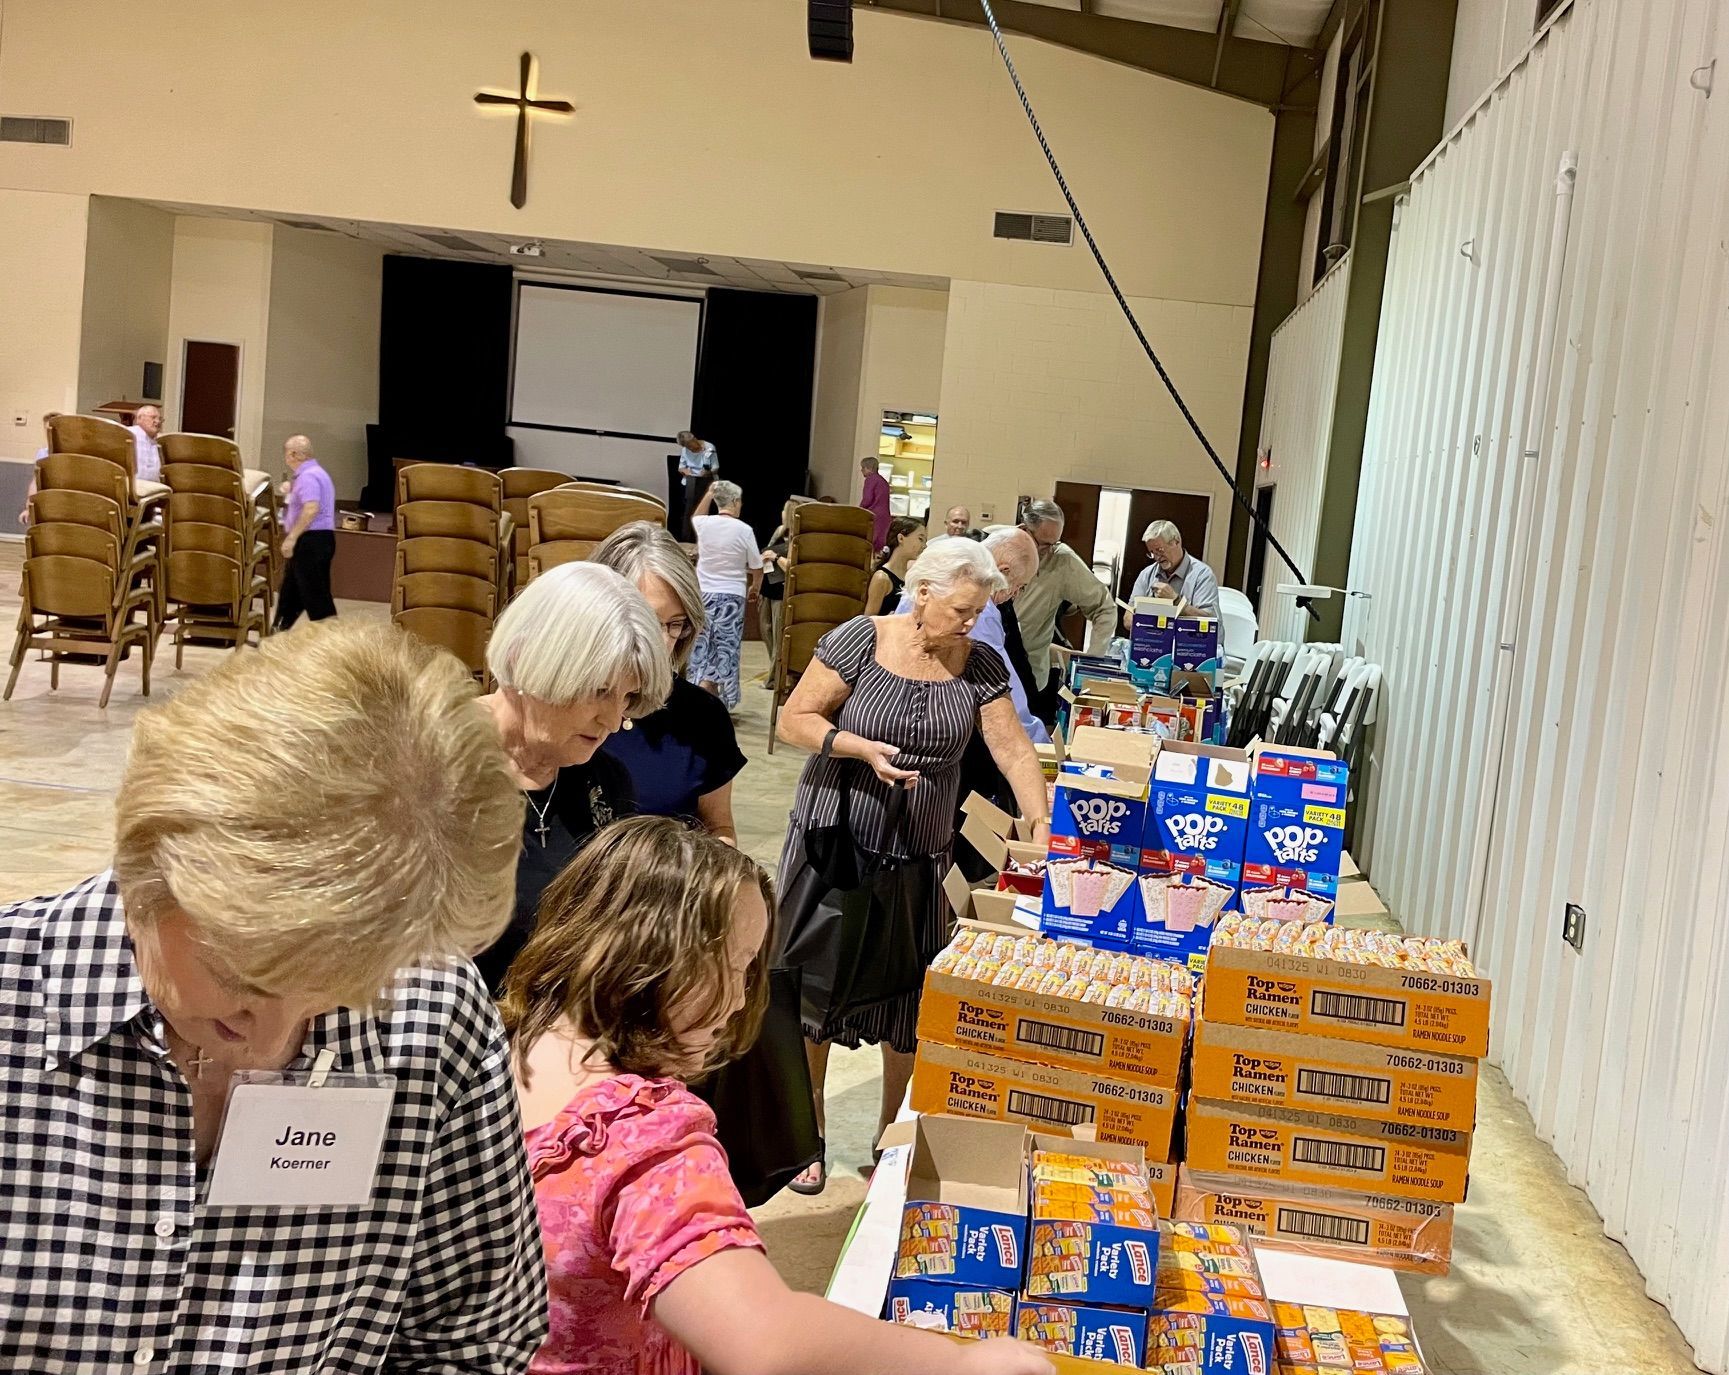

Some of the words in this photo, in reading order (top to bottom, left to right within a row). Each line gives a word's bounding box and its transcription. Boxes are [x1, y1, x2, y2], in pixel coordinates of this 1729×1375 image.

[1266, 957, 1309, 972] 041325
[1338, 966, 1366, 980] 0830
[1247, 976, 1275, 992] Top
[1401, 976, 1479, 996] 70662-01303
[978, 990, 1016, 1003] 041325
[1043, 1002, 1070, 1014] 0830
[1247, 988, 1299, 1005] Ramen
[959, 1001, 984, 1017] Top
[1246, 1003, 1288, 1017] CHICKEN
[958, 1012, 1006, 1031] Ramen
[1101, 1011, 1172, 1033] 70662-01303
[956, 1026, 995, 1042] CHICKEN
[1412, 1029, 1430, 1040] RAMEN
[1432, 1032, 1452, 1042] NOODLE
[1453, 1035, 1466, 1044] SOUP
[1109, 1060, 1126, 1069] RAMEN
[1126, 1062, 1145, 1073] NOODLE
[1146, 1066, 1158, 1076] SOUP
[1233, 1054, 1261, 1070] Top
[1386, 1054, 1463, 1074] 70662-01303
[950, 1071, 975, 1088] Top
[967, 1060, 1006, 1074] 041325
[1032, 1073, 1058, 1085] 0830
[1233, 1066, 1286, 1083] Ramen
[950, 1082, 998, 1102] Ramen
[1092, 1081, 1163, 1104] 70662-01303
[1232, 1081, 1274, 1096] CHICKEN
[947, 1097, 986, 1113] CHICKEN
[1398, 1106, 1415, 1117] RAMEN
[1416, 1109, 1436, 1119] NOODLE
[1437, 1112, 1450, 1120] SOUP
[1258, 1107, 1300, 1121] 041325
[1329, 1117, 1356, 1129] 0830
[276, 1126, 336, 1146] Jane
[1230, 1124, 1257, 1139] Top
[1381, 1122, 1456, 1141] 70662-01303
[1229, 1135, 1281, 1151] Ramen
[270, 1157, 331, 1169] Koerner
[1228, 1151, 1270, 1164] CHICKEN
[1392, 1174, 1410, 1184] RAMEN
[1410, 1177, 1430, 1187] NOODLE
[1431, 1179, 1444, 1188] SOUP
[1215, 1194, 1242, 1209] Top
[1365, 1196, 1440, 1217] 70662-01303
[1214, 1204, 1265, 1222] Ramen
[967, 1230, 978, 1254] Pack
[976, 1226, 990, 1262] Variety
[998, 1227, 1013, 1265] Lance
[1100, 1247, 1111, 1272] Pack
[1109, 1243, 1122, 1279] Variety
[1131, 1244, 1146, 1282] Lance
[895, 1300, 905, 1322] nce
[1093, 1328, 1107, 1360] Variet
[1215, 1338, 1225, 1363] Pack
[1224, 1334, 1236, 1370] Variety
[1246, 1335, 1261, 1373] Lance
